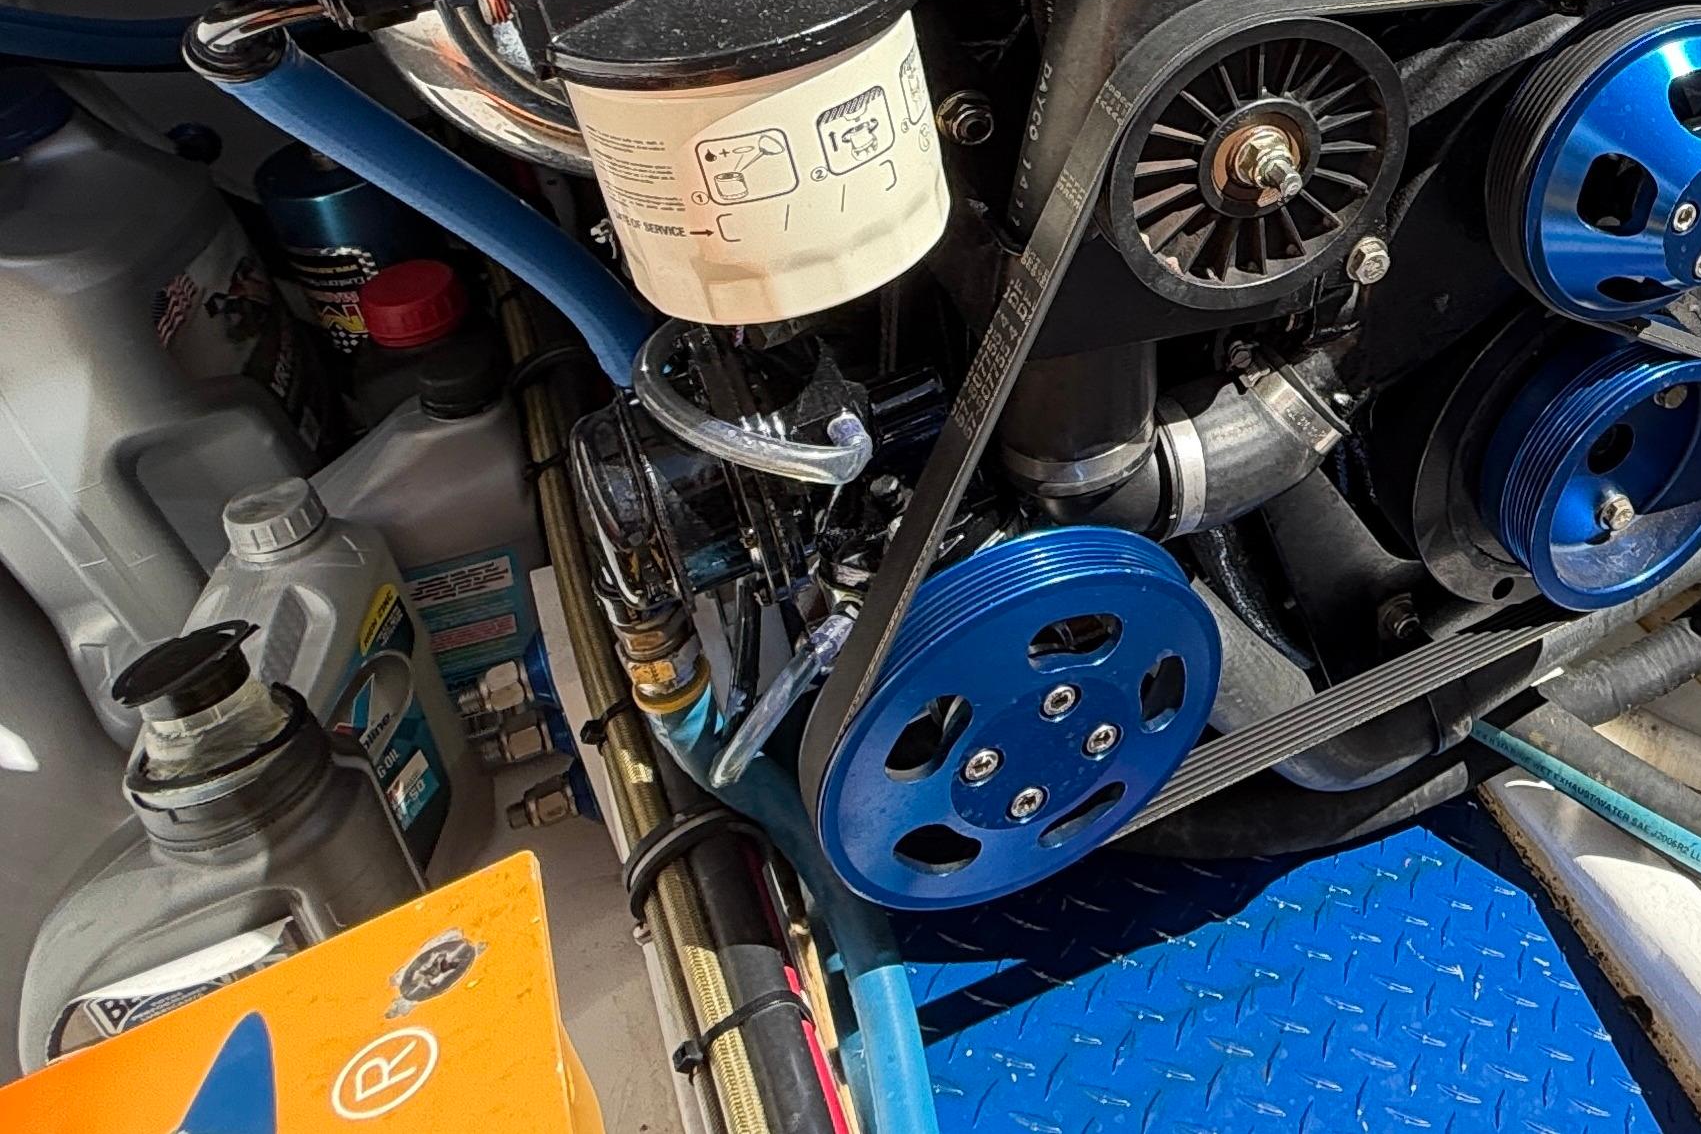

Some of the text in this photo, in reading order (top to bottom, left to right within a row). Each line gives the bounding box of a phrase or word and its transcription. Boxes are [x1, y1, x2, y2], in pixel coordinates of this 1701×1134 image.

[1027, 61, 1054, 142] DAYCO
[643, 219, 687, 239] SERVICE
[377, 589, 394, 618] ZINC
[1553, 770, 1630, 822] EXHAUST/WATER
[1631, 816, 1650, 833] SAE
[1651, 827, 1689, 854] J2006R2
